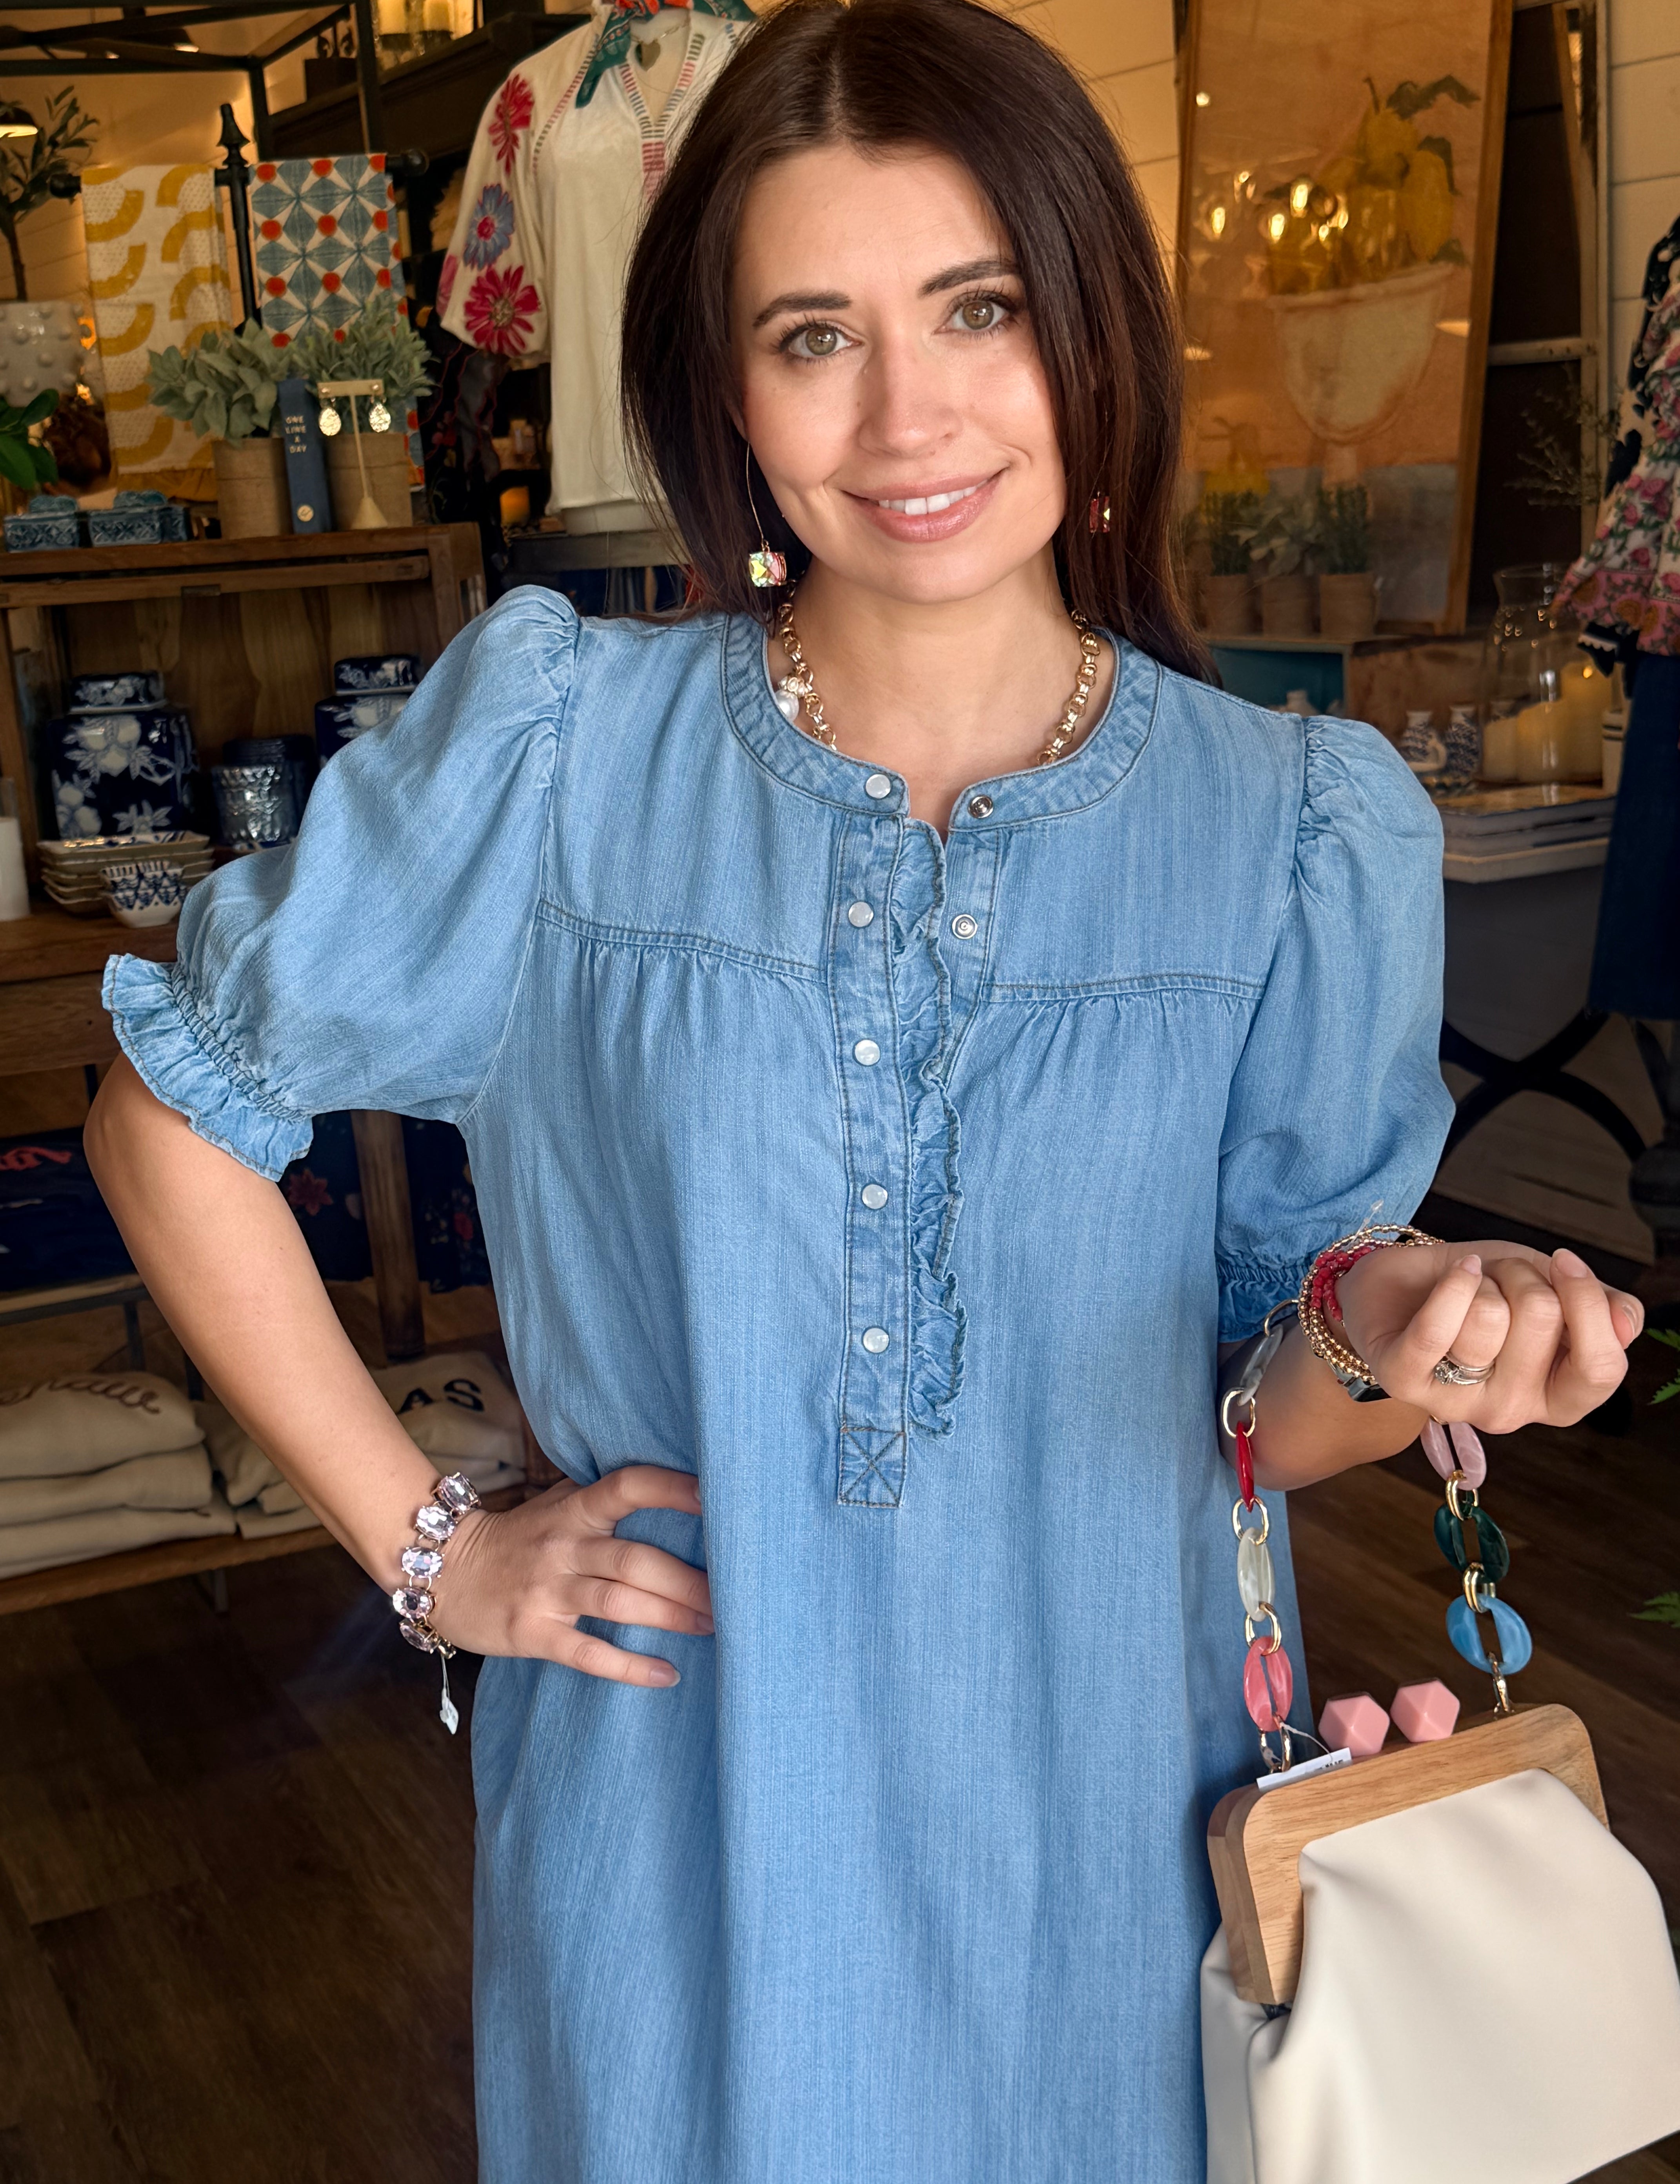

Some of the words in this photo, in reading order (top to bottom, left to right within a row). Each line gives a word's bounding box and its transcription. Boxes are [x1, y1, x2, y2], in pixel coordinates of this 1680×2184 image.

[285, 415, 304, 424] ONE
[285, 426, 306, 434] LINE
[289, 445, 307, 453] DAY
